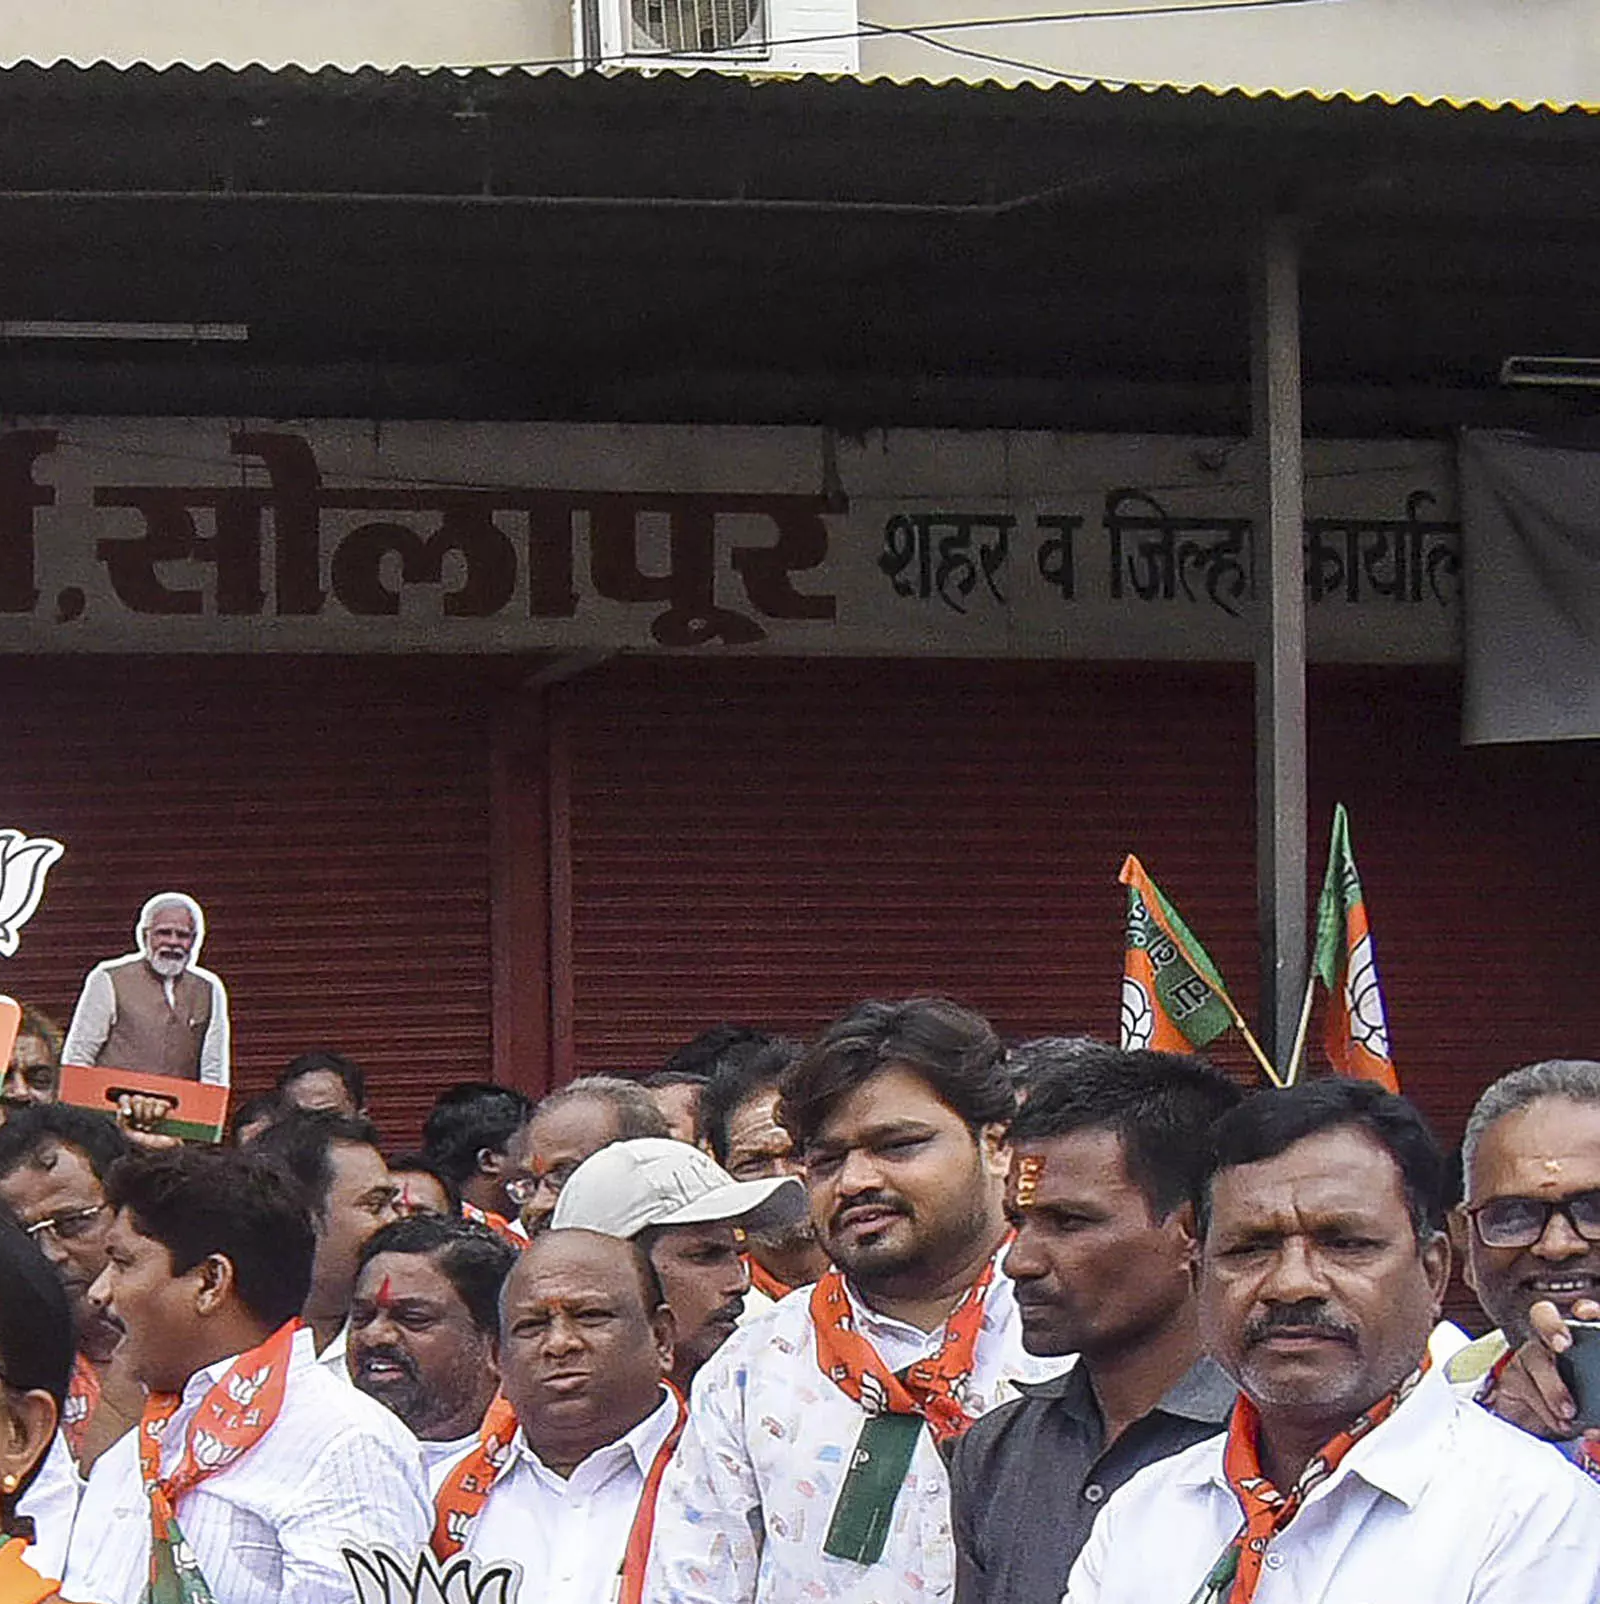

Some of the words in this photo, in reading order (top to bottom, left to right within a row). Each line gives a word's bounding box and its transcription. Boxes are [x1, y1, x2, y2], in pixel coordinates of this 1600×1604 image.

[94, 431, 849, 647] सोलापूर
[881, 511, 1018, 614] शहर
[1036, 513, 1084, 601] व
